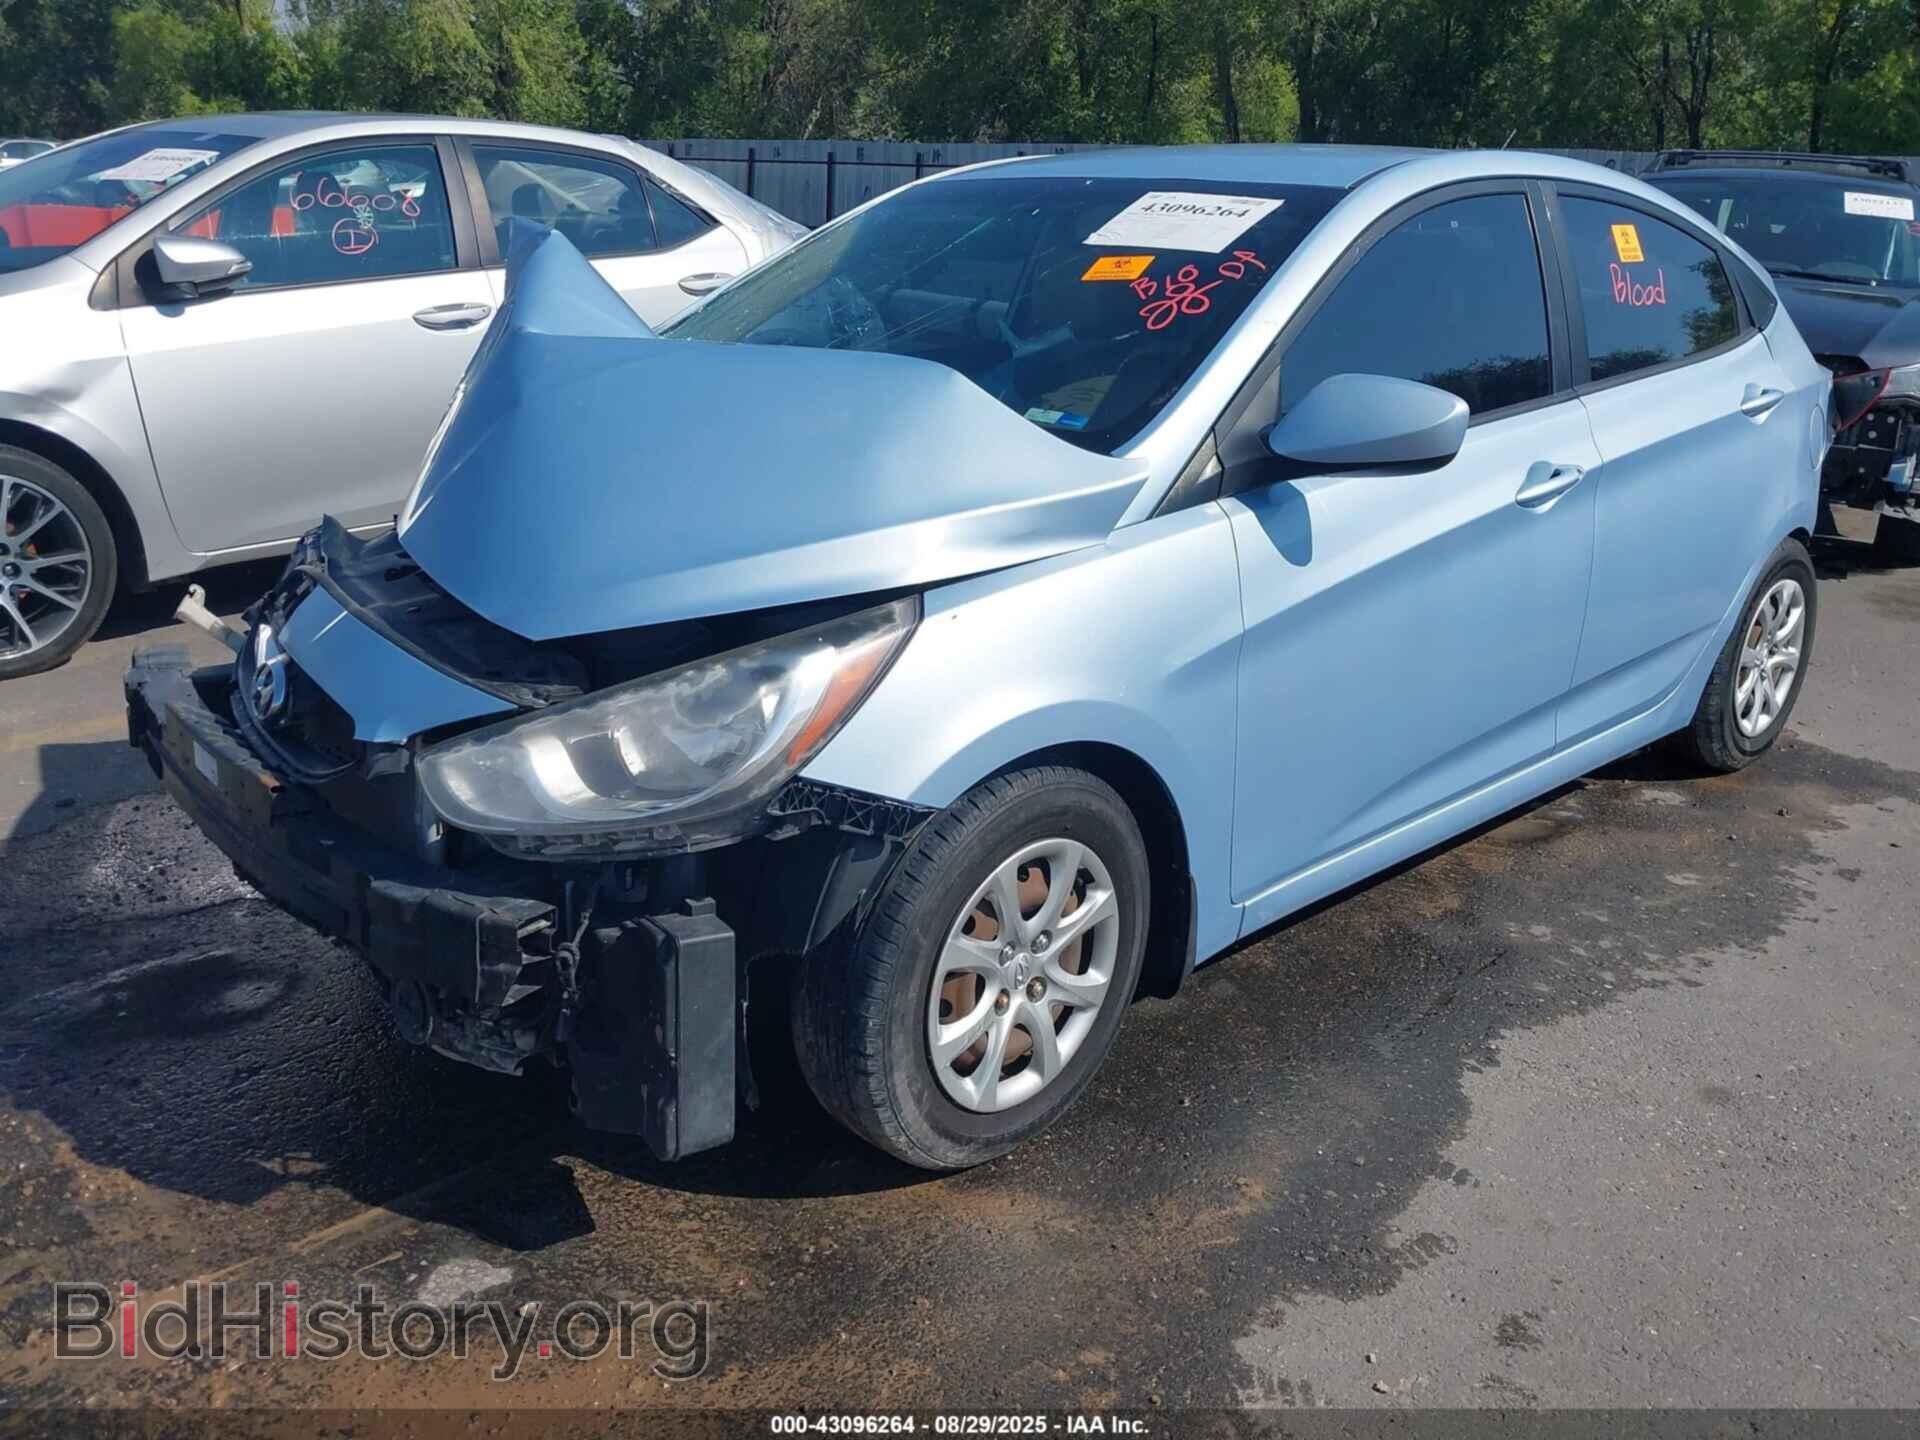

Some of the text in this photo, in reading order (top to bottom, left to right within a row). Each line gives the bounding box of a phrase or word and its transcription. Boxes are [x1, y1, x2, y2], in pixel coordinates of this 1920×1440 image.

[289, 171, 421, 216] 66608
[1141, 202, 1251, 218] 43096264
[1609, 263, 1666, 306] Blood
